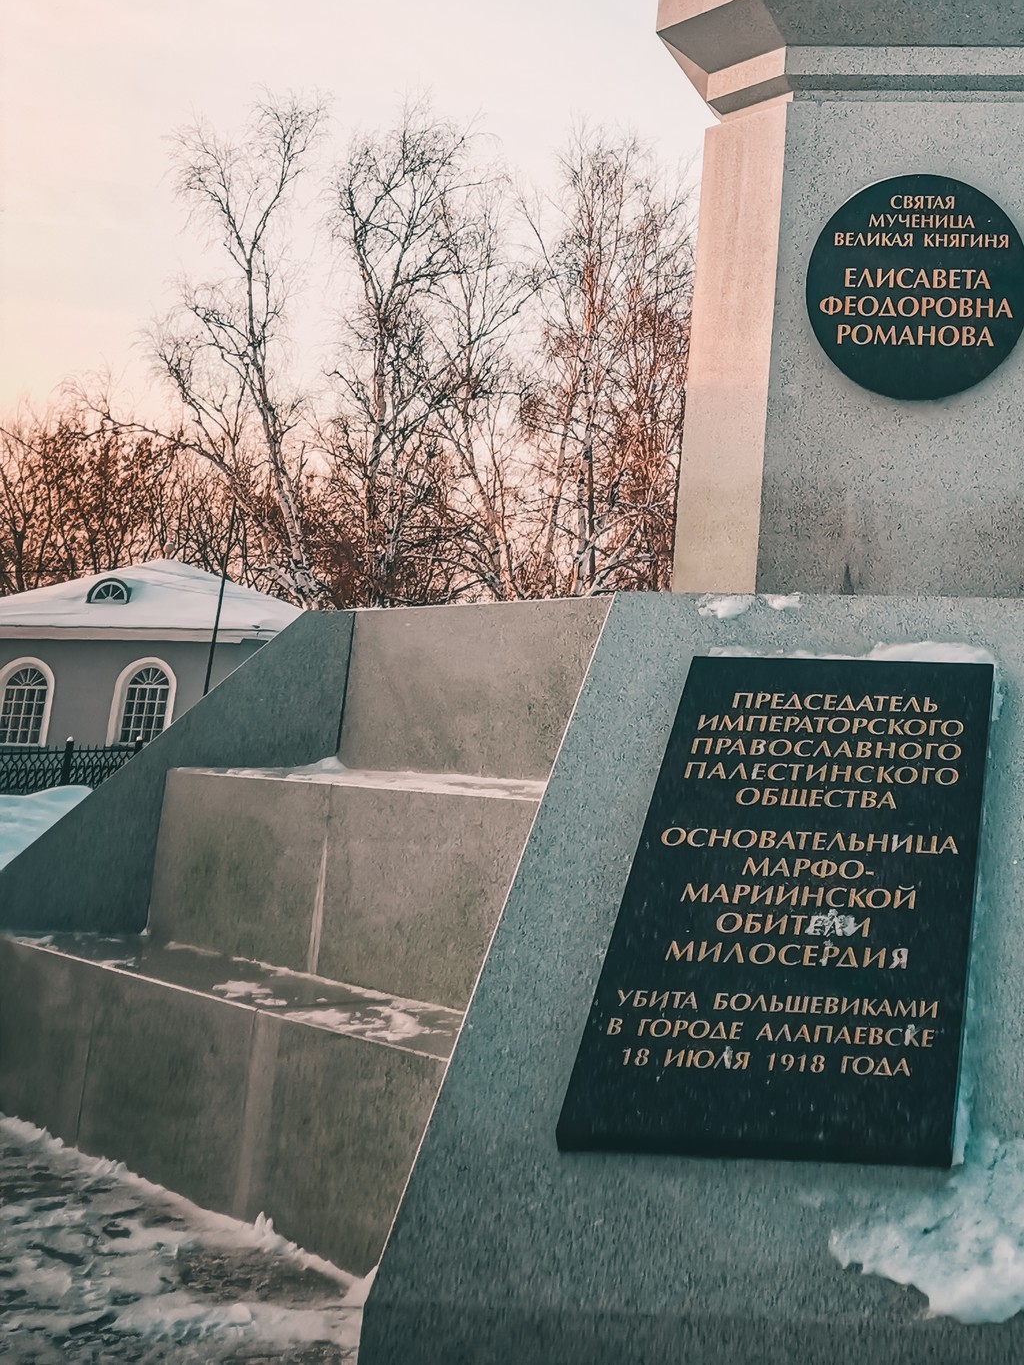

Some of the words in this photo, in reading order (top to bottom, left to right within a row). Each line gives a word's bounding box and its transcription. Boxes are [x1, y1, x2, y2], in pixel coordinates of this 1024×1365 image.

[890, 195, 955, 209] СВЯТАЯ
[868, 214, 975, 229] МУЧЕНИЦА
[834, 232, 913, 247] ВЕЛИКАЯ
[923, 234, 1009, 248] КНЯГИНЯ
[844, 268, 991, 290] ЕЛИСАВЕТА
[819, 296, 1013, 318] ФЕОДОРОВНА
[836, 324, 994, 347] РОМАНОВА
[731, 692, 938, 713] ПРЕДСЕДАТЕЛЬ
[697, 714, 964, 737] ИМПЕРАТОРСКОГО
[690, 737, 962, 761] ПРАВОСЛАВНОГО
[683, 761, 960, 786] ПАЛЕСТИНСКОГО
[735, 787, 897, 810] ОБЩЕСТВА
[661, 827, 959, 855] ОСНОВАТЕЛЬНИЦА
[741, 857, 875, 880] МАРФО-
[679, 883, 917, 910] МАРИИНСКОЙ
[664, 940, 909, 970] МИЛОСЕРДИЯ
[617, 989, 698, 1010] УБИТА
[713, 993, 939, 1019] БОЛЬШЕВИКАМИ
[606, 1018, 623, 1035] В
[637, 1019, 743, 1041] ГОРОДЕ
[756, 1023, 934, 1048] АЛАПАЕВСКЕ
[622, 1048, 648, 1066] 18
[664, 1049, 750, 1071] ИЮЛЯ
[767, 1053, 825, 1073] 1918
[840, 1055, 911, 1077] ГОДА
